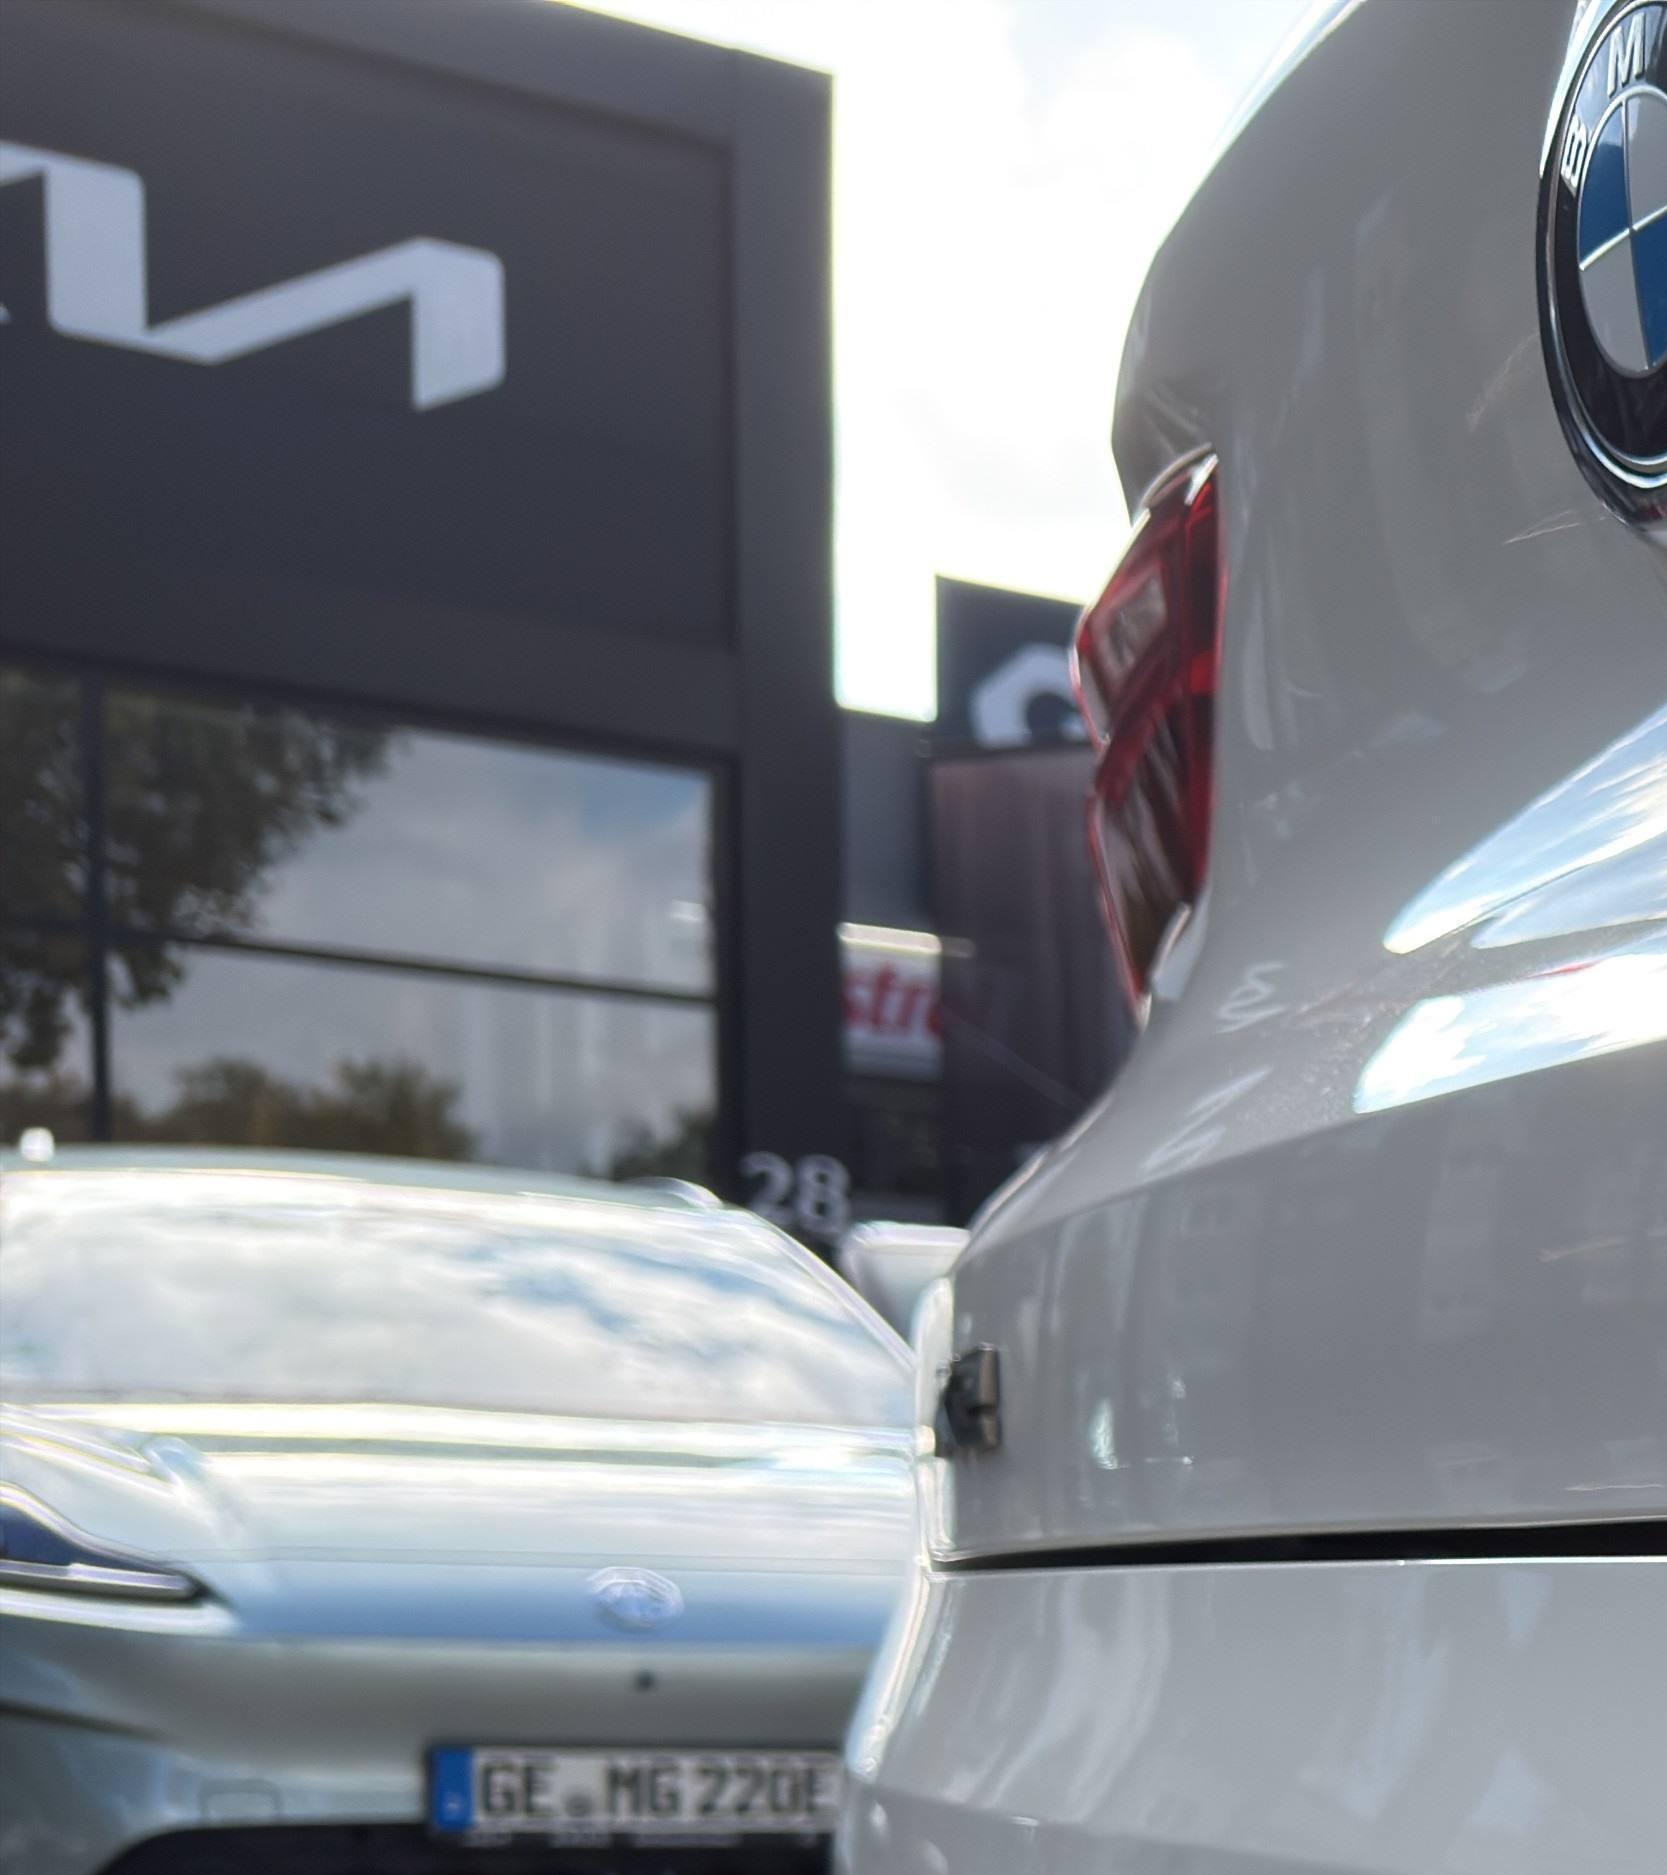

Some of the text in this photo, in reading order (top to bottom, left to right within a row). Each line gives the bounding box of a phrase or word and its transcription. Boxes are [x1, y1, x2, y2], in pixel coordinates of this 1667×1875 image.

[739, 1151, 850, 1233] 28
[481, 1762, 558, 1819] GE
[604, 1762, 681, 1819] MG
